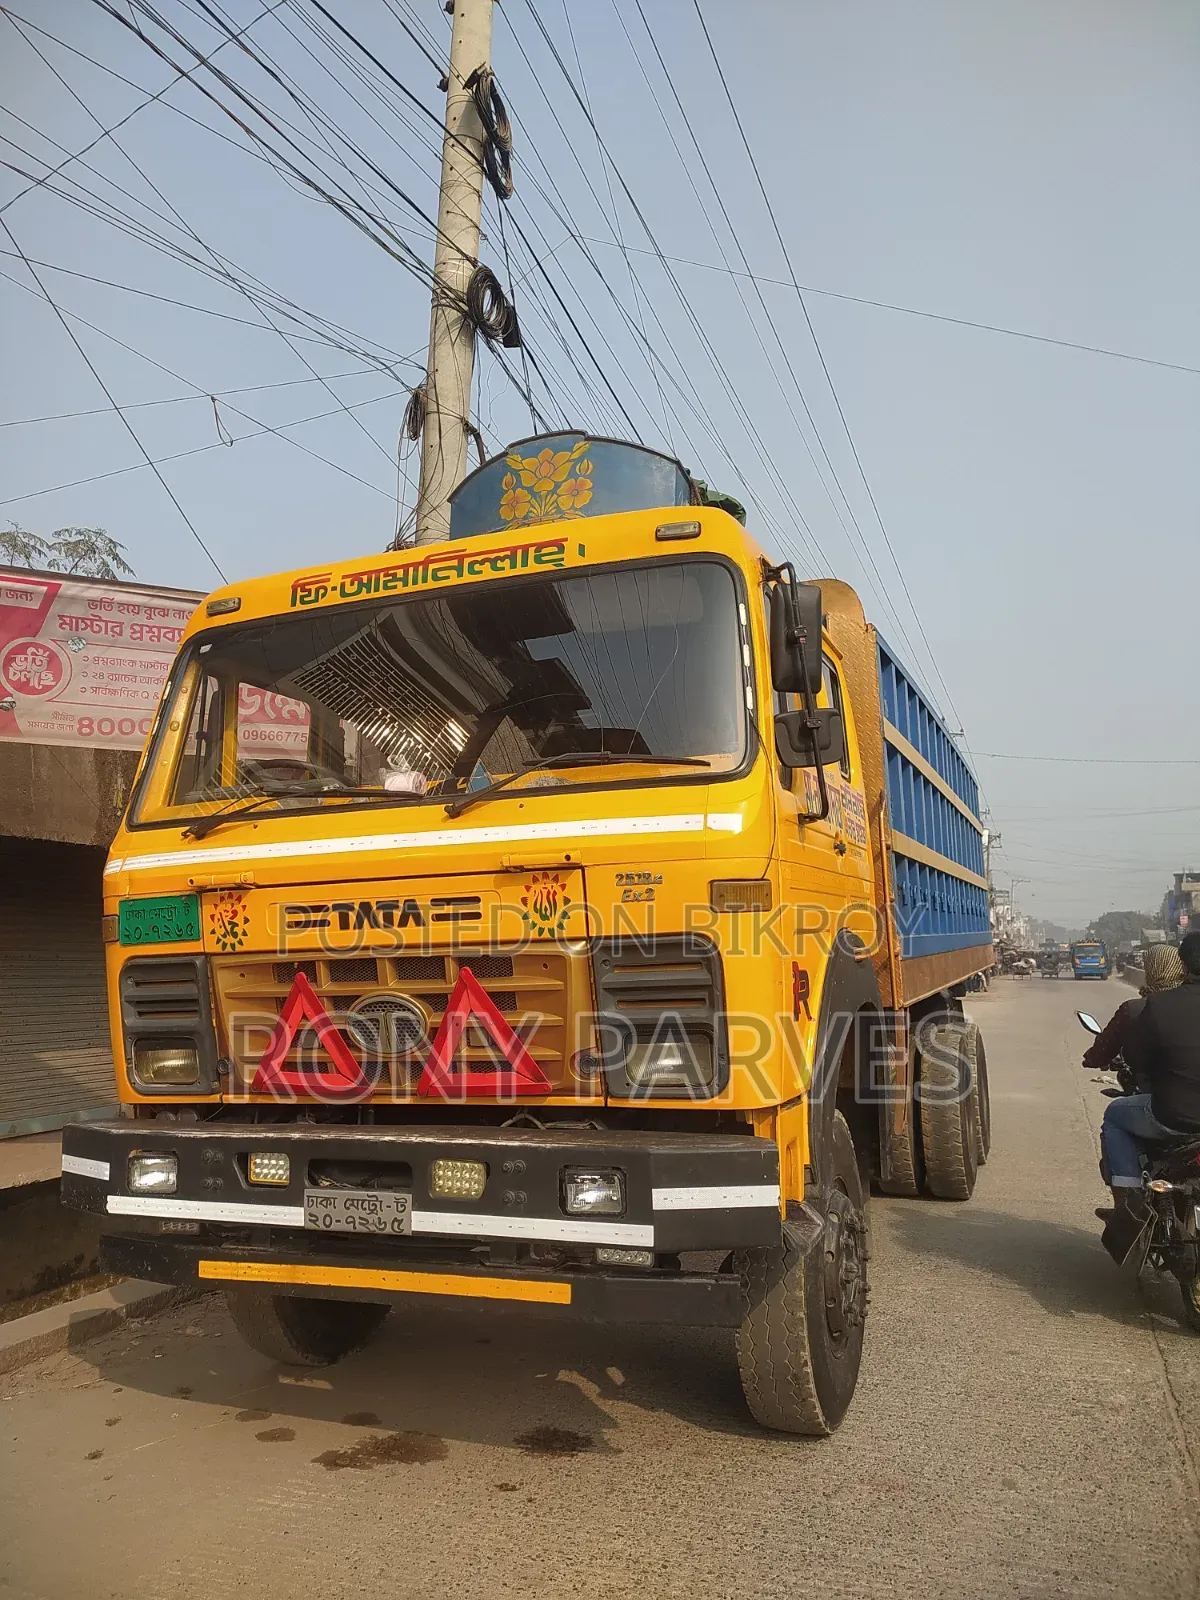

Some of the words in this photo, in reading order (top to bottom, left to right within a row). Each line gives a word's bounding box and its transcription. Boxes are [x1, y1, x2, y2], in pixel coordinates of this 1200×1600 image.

[5, 588, 34, 602] জন্য
[87, 597, 115, 612] ভর্তি
[117, 602, 141, 616] হয়ে
[144, 606, 170, 620] বুঝে
[57, 613, 124, 638] মাস্টার
[129, 622, 185, 643] প্রশ্নব্য
[139, 660, 169, 672] মাস্টার
[92, 672, 105, 680] ২৪
[107, 672, 138, 684] ব্যাচের
[139, 674, 167, 686] আর্কা
[90, 684, 140, 699] সার্বক্ষণিক
[51, 711, 75, 722] সীমিত
[56, 723, 75, 731] জন্য
[125, 908, 147, 920] ঢাকা
[329, 898, 426, 931] TATA
[124, 922, 194, 941] ২০-৭২৬৫
[306, 1194, 337, 1209] ঢাকা
[308, 1212, 404, 1234] ২০-৭২৬৫
